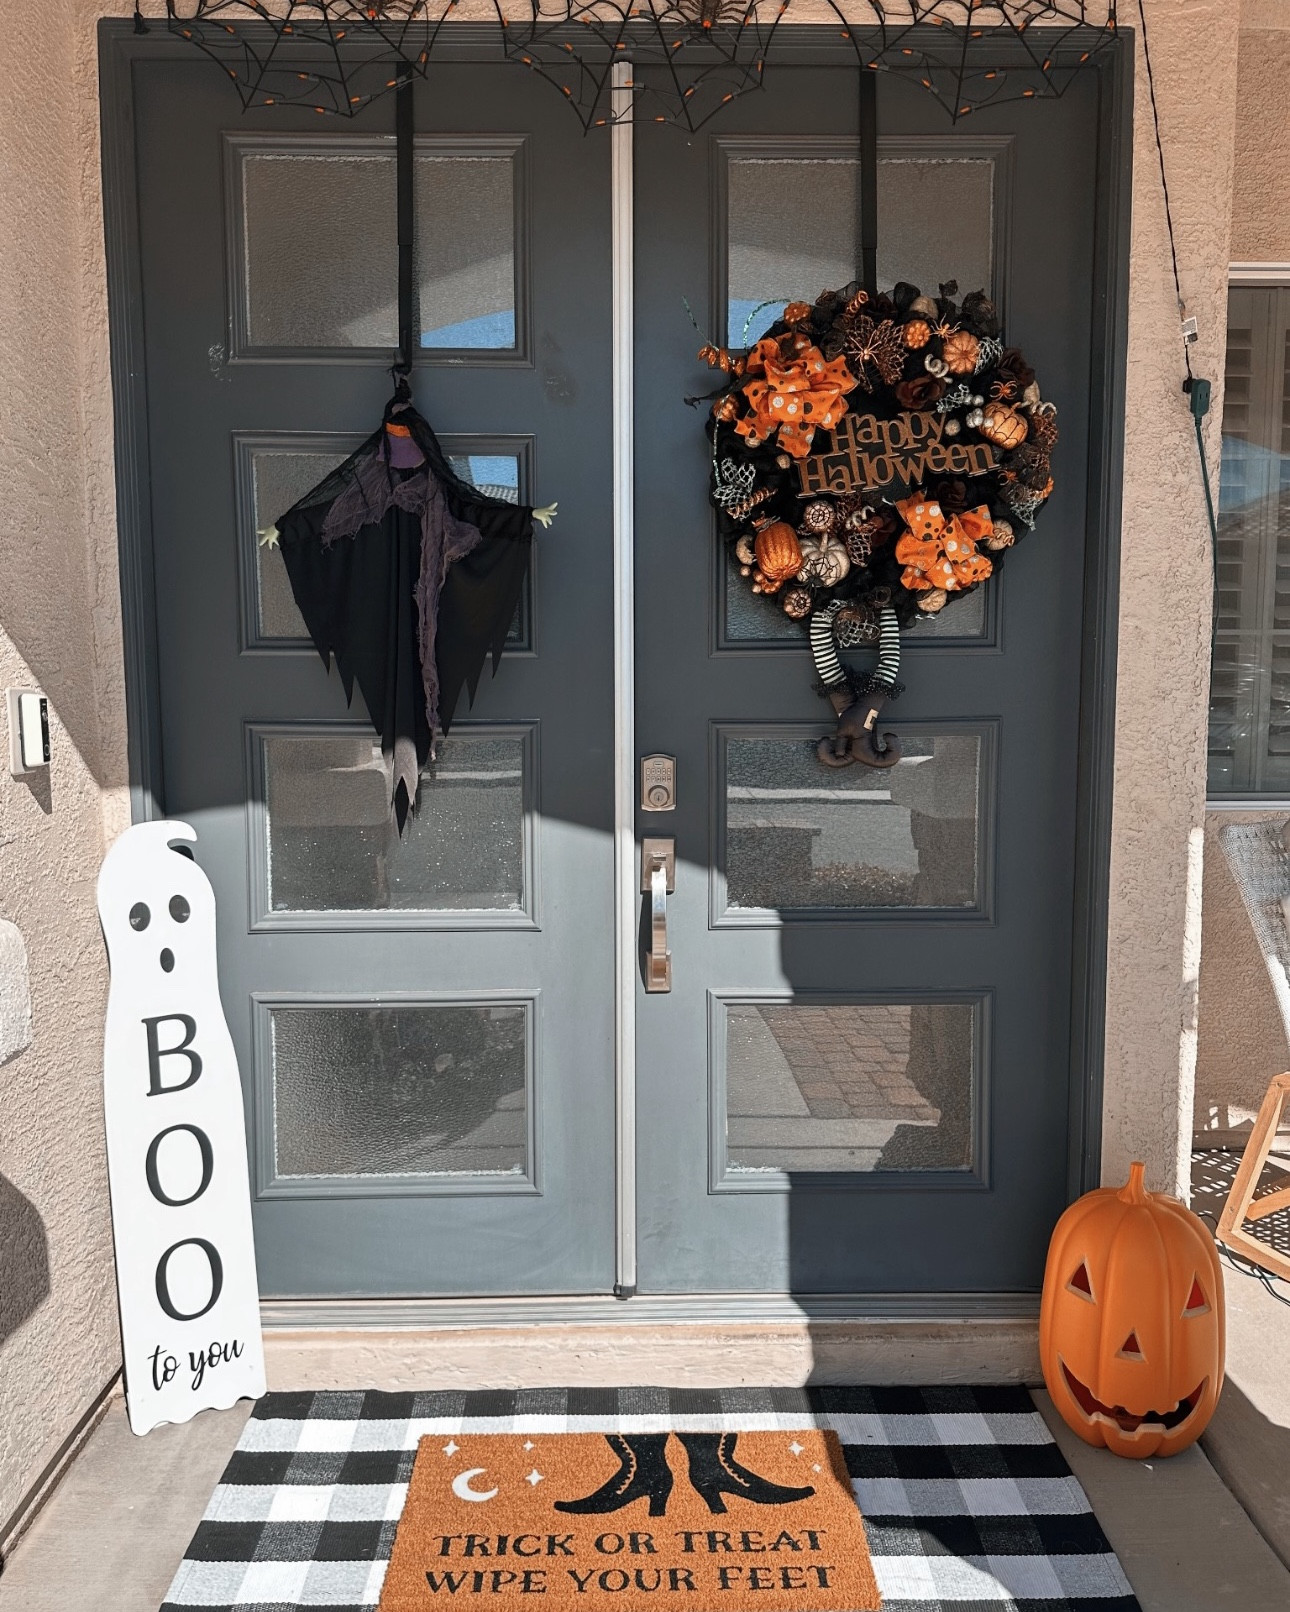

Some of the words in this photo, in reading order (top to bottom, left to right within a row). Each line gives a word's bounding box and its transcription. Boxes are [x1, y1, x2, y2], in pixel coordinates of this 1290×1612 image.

[830, 411, 947, 457] Happy
[795, 442, 1000, 498] Halloween
[141, 1013, 223, 1321] BOO
[147, 1344, 181, 1391] to
[188, 1338, 245, 1391] you
[431, 1533, 569, 1557] TRICK
[594, 1532, 659, 1555] OR
[674, 1530, 827, 1553] TREAT
[425, 1570, 547, 1594] WIPE
[567, 1569, 698, 1593] YOUR
[716, 1566, 836, 1589] FEET
